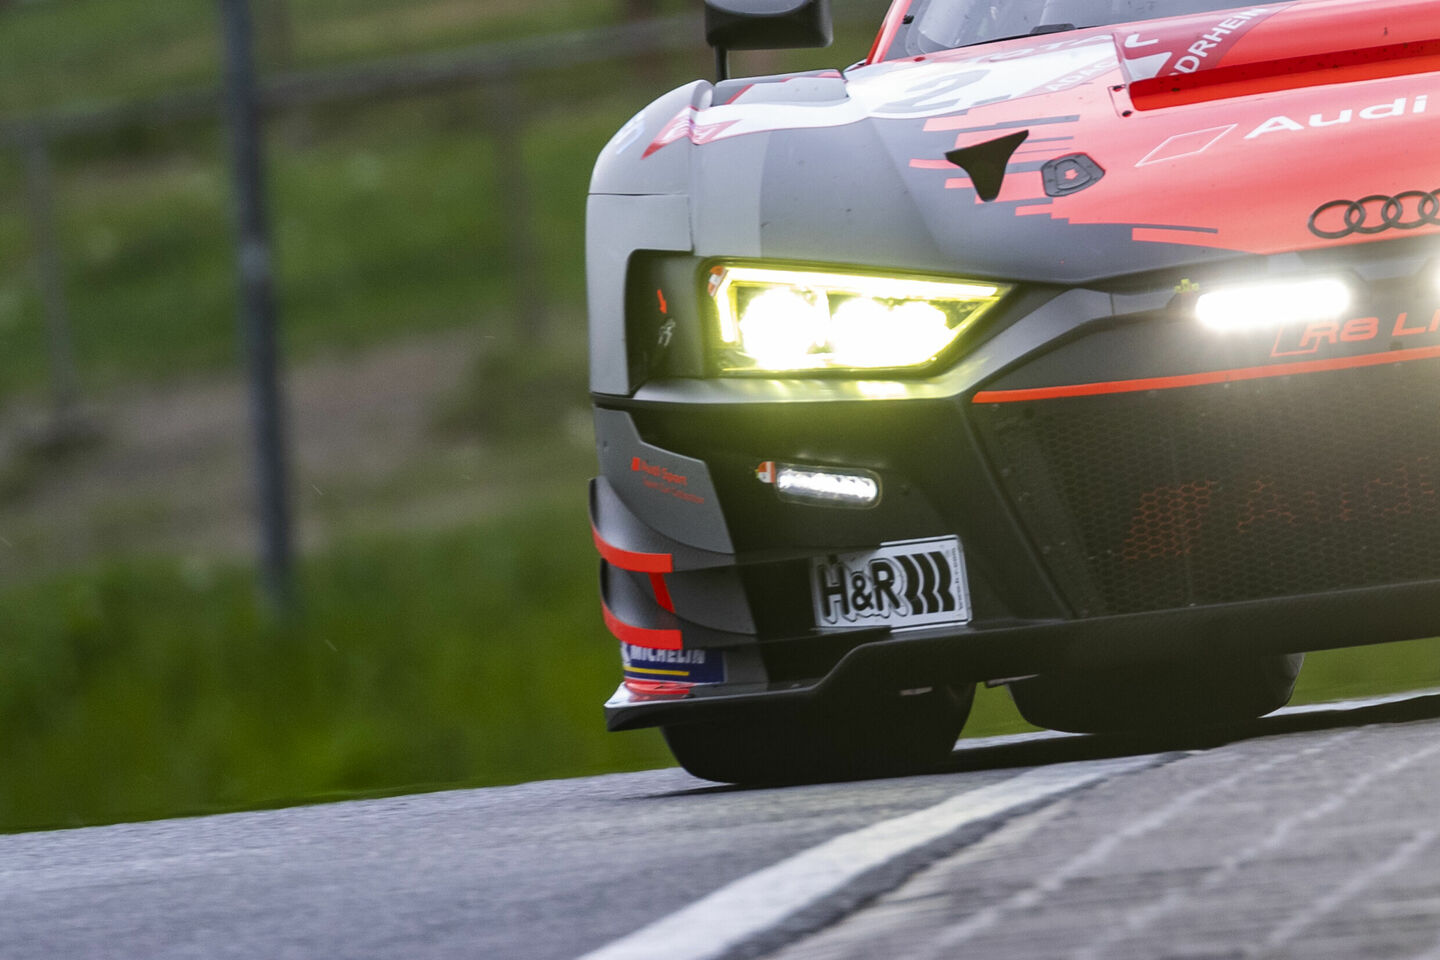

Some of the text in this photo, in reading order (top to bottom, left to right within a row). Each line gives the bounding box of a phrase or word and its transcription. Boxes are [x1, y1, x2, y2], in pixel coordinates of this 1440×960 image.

[1244, 95, 1428, 139] Audi
[1298, 316, 1380, 348] R8
[817, 560, 902, 620] H&R
[630, 645, 706, 664] MICHELIN
